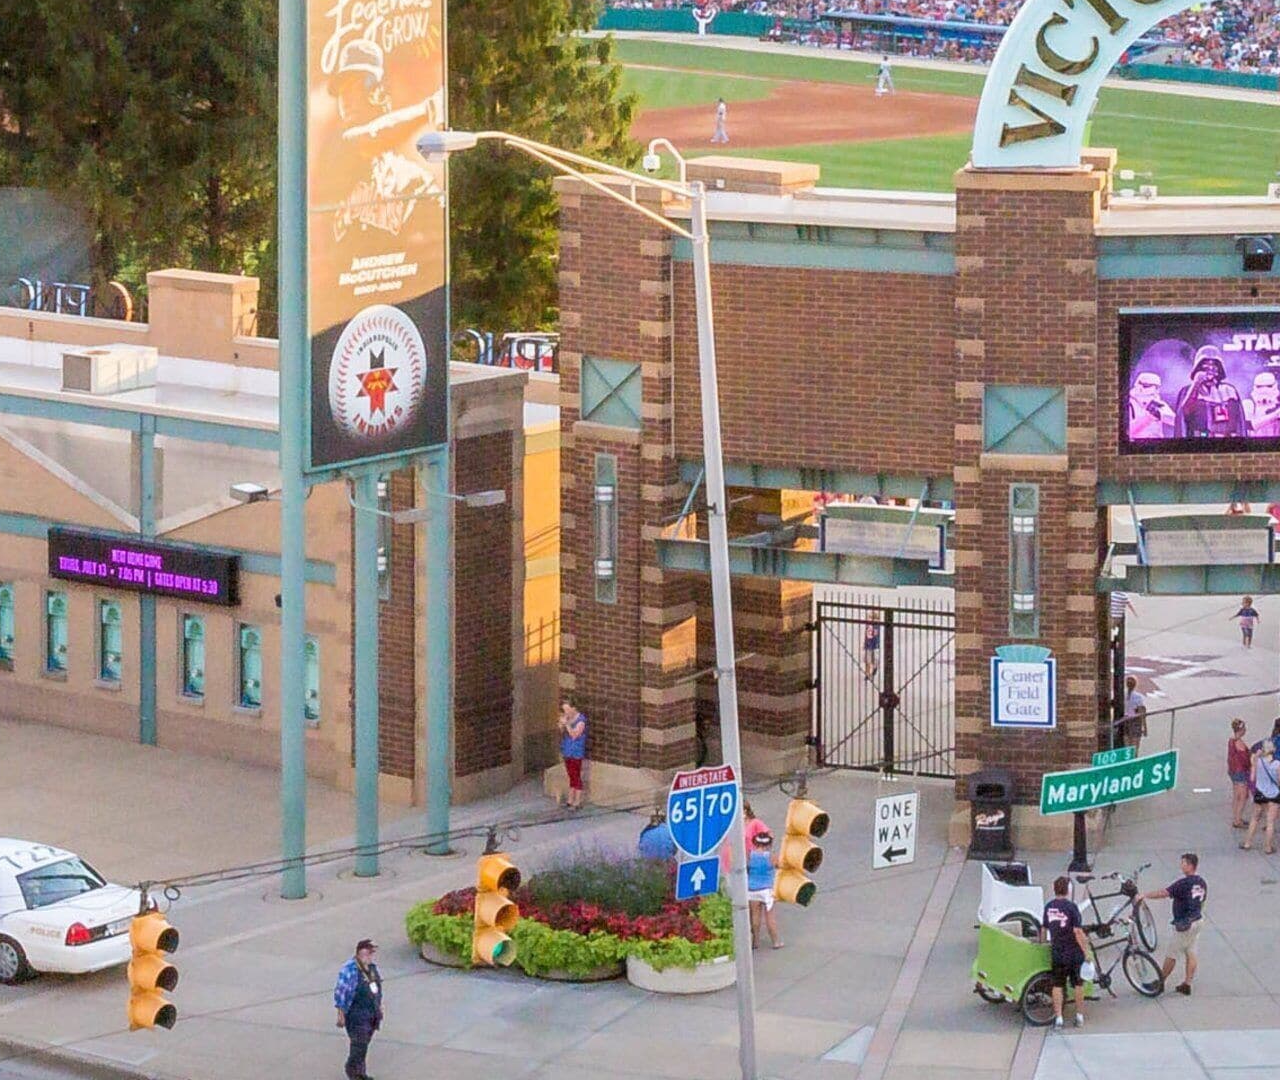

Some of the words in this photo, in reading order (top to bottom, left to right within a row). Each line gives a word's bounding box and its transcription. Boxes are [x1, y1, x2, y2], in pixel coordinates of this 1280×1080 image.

[382, 9, 430, 53] GROW
[352, 405, 403, 438] INDIANS
[82, 560, 97, 575] JULY
[98, 563, 107, 577] 13
[134, 569, 145, 583] PM
[154, 572, 174, 588] GATES
[175, 574, 192, 590] OPEN
[192, 577, 201, 592] AT
[201, 579, 218, 595] 5:30
[1001, 668, 1045, 683] Center
[1008, 685, 1040, 700] Field
[1006, 701, 1042, 716] Gate
[1097, 752, 1118, 765] 100
[1124, 749, 1132, 760] S
[679, 769, 729, 788] INTERSTATE
[1047, 769, 1144, 805] Maryland
[1151, 761, 1172, 785] St
[671, 797, 698, 824] 65
[705, 791, 733, 817] 70
[880, 800, 913, 820] ONE
[878, 823, 913, 844] WAY
[30, 925, 62, 939] POLICE
